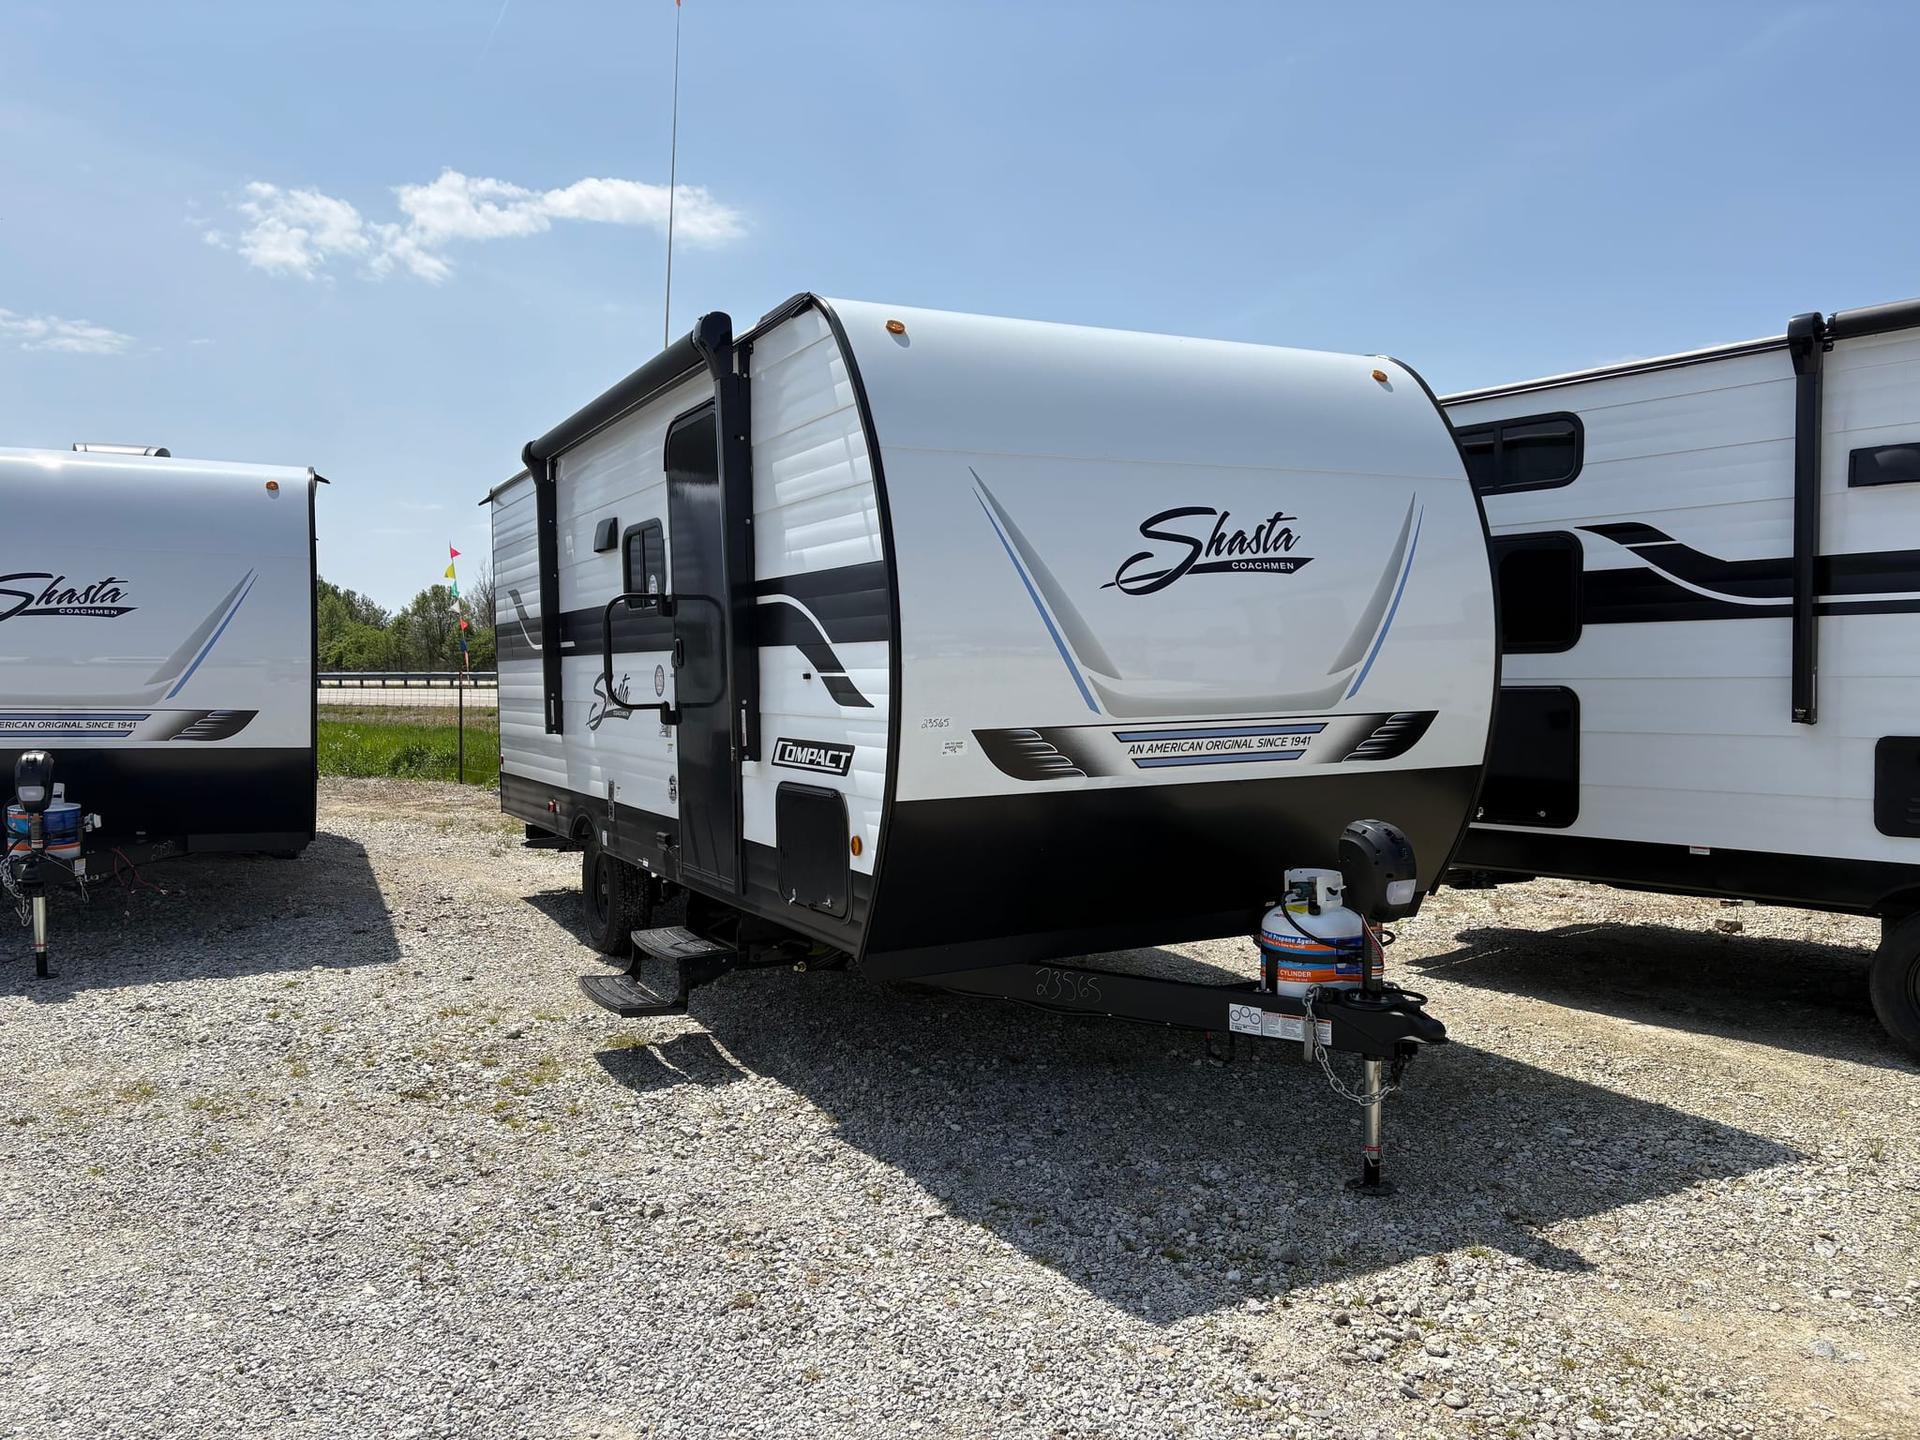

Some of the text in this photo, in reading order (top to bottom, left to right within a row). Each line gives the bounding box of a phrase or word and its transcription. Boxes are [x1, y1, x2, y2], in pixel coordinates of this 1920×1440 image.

[1113, 506, 1301, 596] Shasta
[1231, 561, 1295, 570] COACHMEN
[37, 721, 84, 729] ORIGINAL
[85, 721, 115, 729] SINCE
[117, 721, 137, 729] 1941
[921, 718, 950, 729] 23565
[1128, 735, 1312, 755] AN AMERICAN ORIGINAL SINCE 1941
[773, 740, 852, 773] COMPACT
[1279, 969, 1312, 978] CYLINDER
[1035, 967, 1102, 1002] 23565
